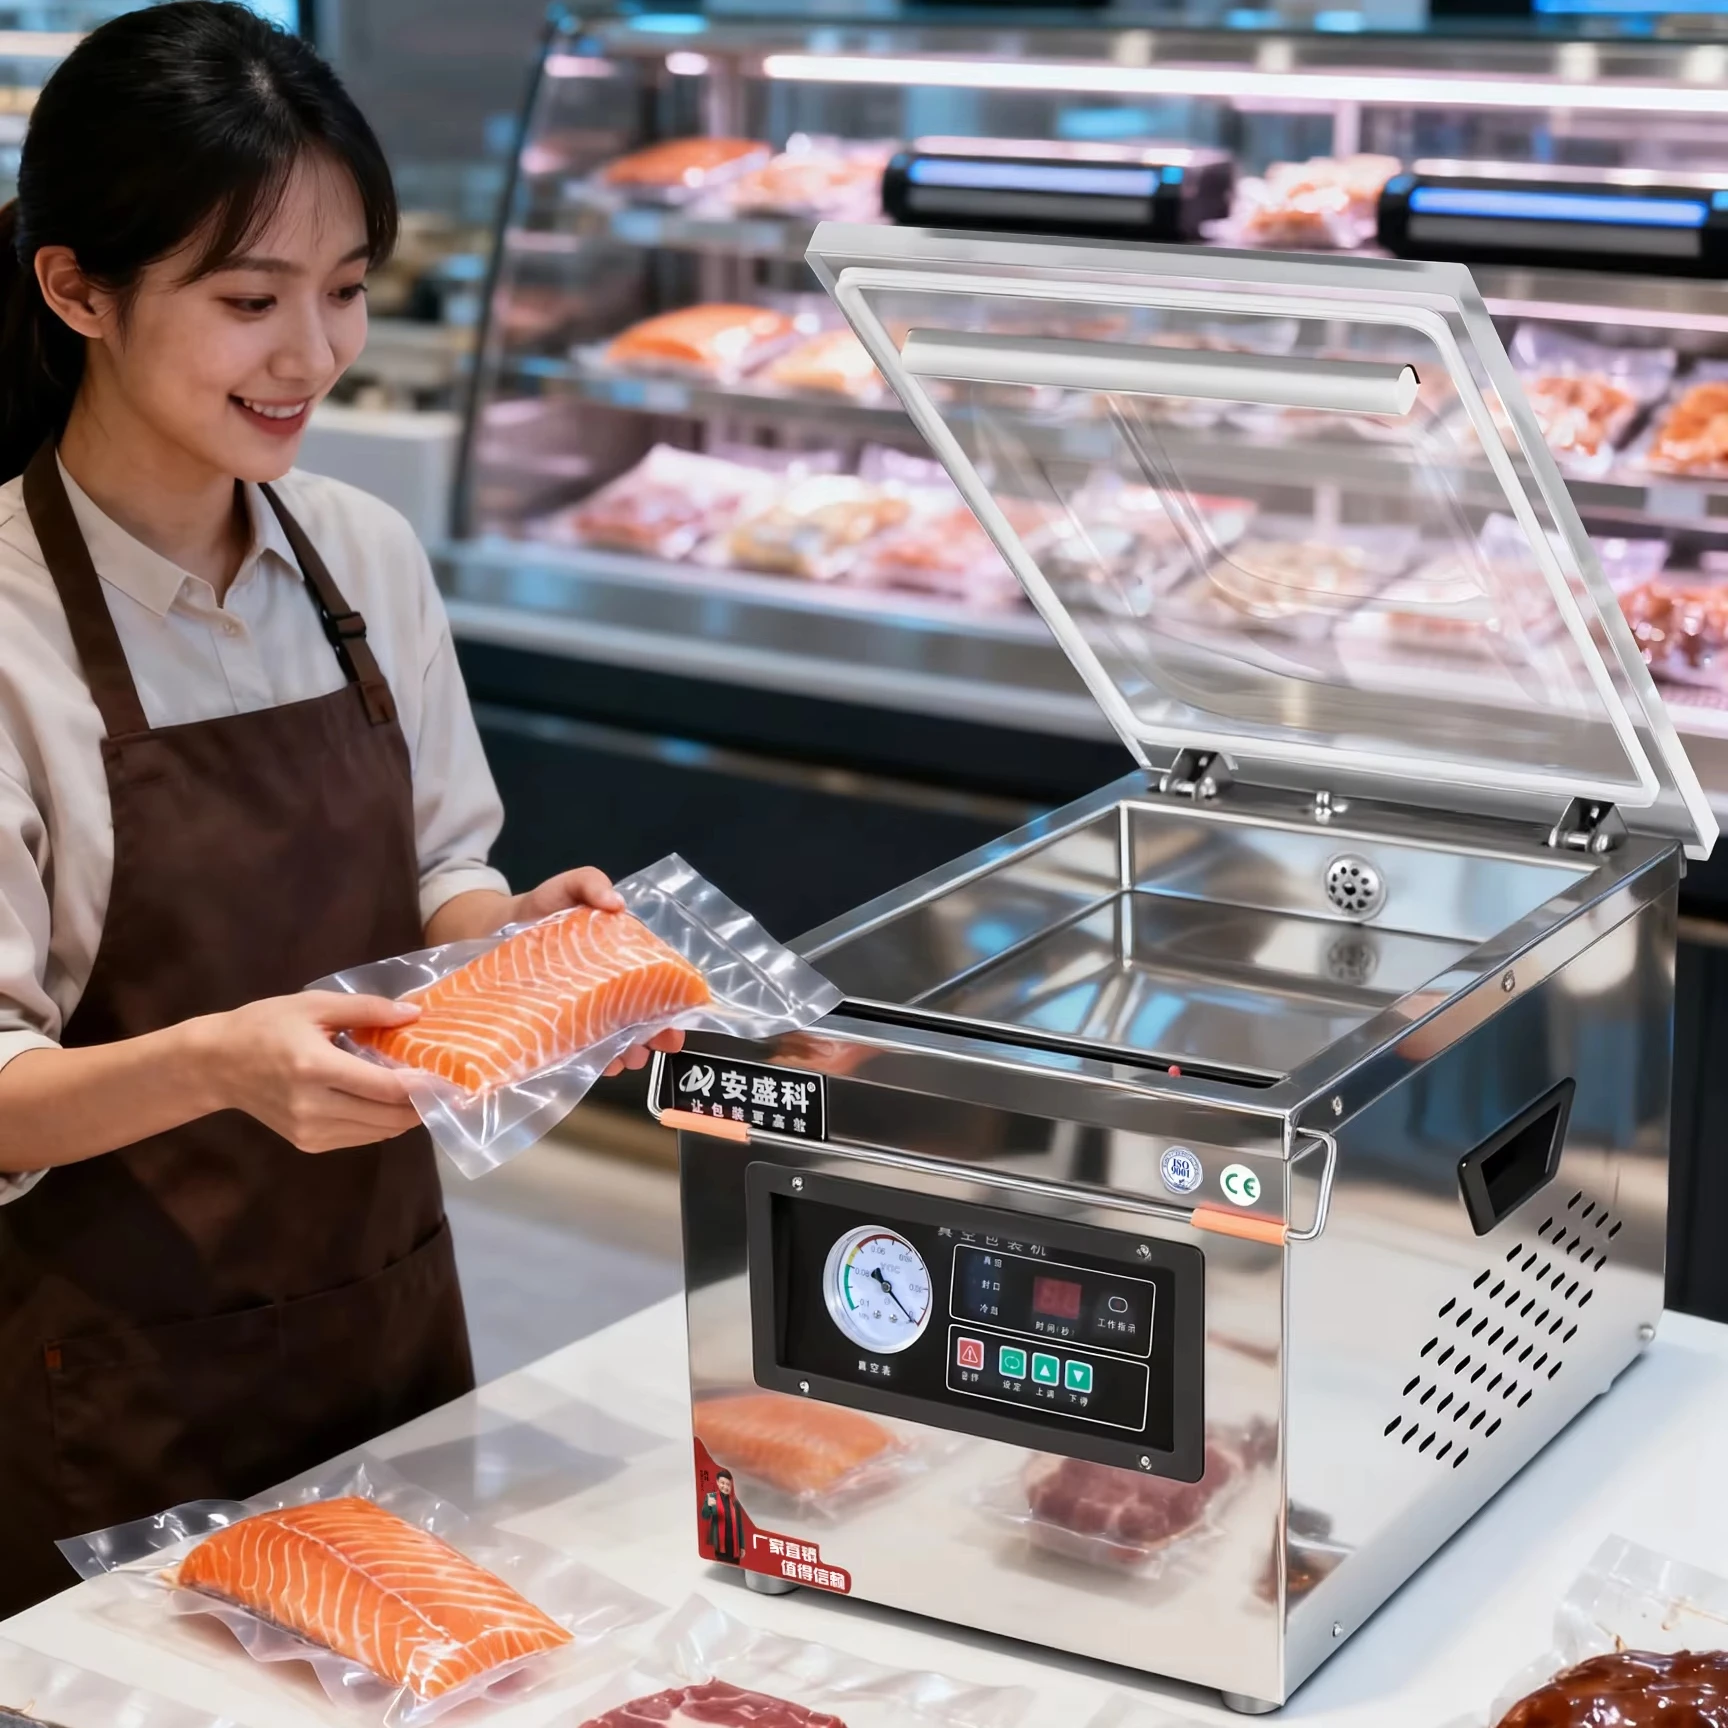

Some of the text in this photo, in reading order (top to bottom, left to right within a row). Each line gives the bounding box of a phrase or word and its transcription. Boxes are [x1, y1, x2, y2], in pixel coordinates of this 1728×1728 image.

[1173, 1158, 1190, 1170] ISO
[1171, 1165, 1190, 1178] 9001
[1225, 1173, 1256, 1198] CE
[981, 1280, 1001, 1291] 封口
